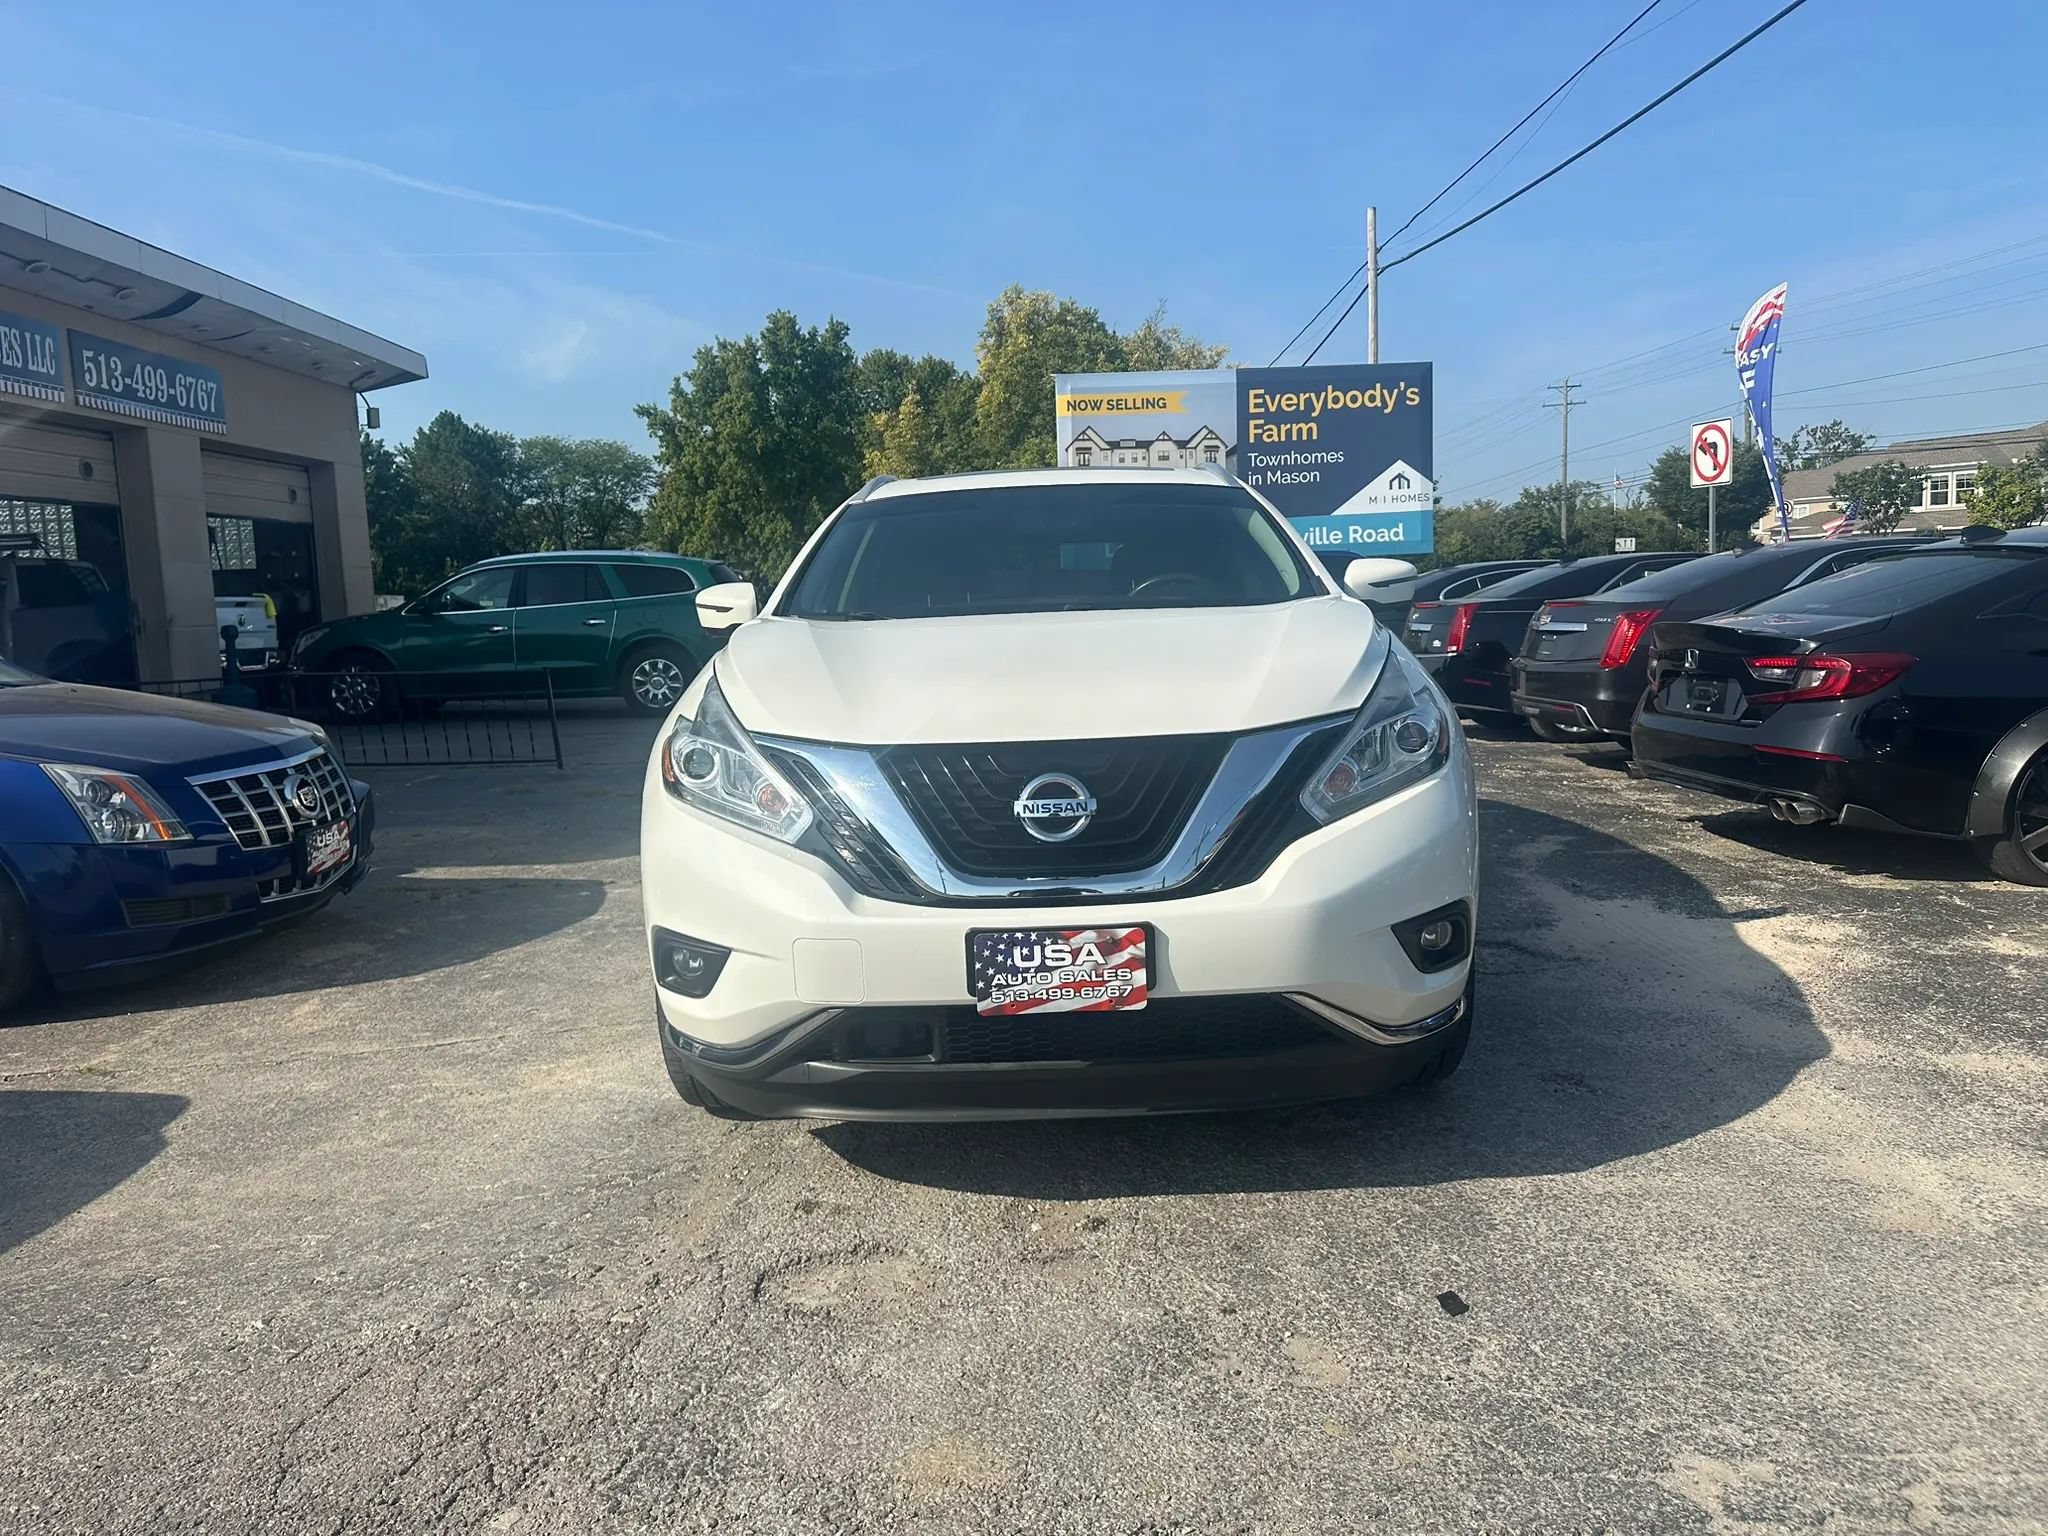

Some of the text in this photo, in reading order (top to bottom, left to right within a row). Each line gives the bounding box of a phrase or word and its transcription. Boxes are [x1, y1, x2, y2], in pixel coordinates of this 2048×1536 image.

[0, 325, 55, 375] ES LLC
[82, 349, 217, 413] 513-499-6767
[1066, 397, 1167, 412] NOW SELLING
[1248, 381, 1420, 417] Everybody's
[1248, 418, 1318, 443] Farm
[1248, 450, 1344, 467] Townhomes
[1248, 470, 1320, 486] in Mason
[1391, 493, 1430, 504] HOMES
[1302, 523, 1405, 545] ville Road
[1022, 802, 1088, 814] NISSAN
[316, 830, 340, 847] USA
[1013, 942, 1107, 968] USA
[991, 968, 1132, 986] AUTO SALES
[991, 985, 1133, 1003] 513-499-6767
